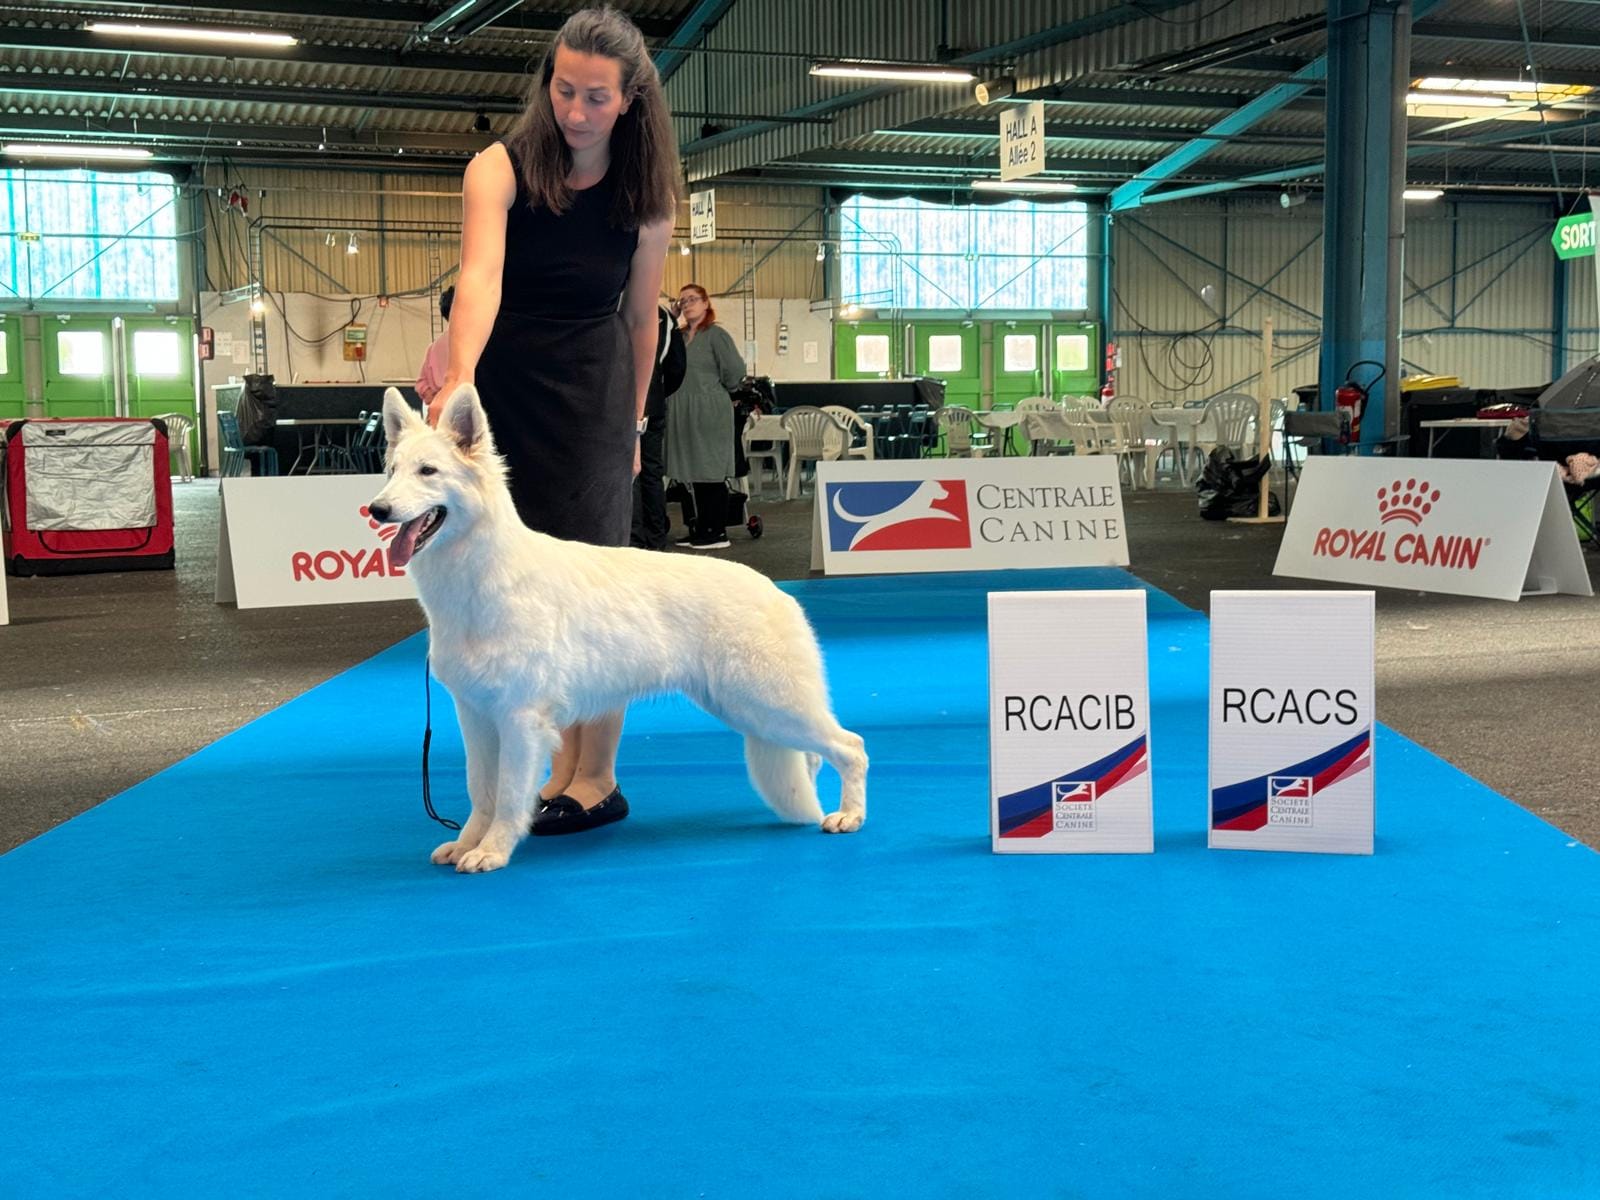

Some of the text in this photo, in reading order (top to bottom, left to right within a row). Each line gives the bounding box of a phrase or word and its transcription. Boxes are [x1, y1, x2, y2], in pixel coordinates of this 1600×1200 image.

[1006, 115, 1037, 143] HALL A
[1008, 140, 1036, 168] Allée 2
[692, 191, 714, 219] HALL A
[709, 220, 714, 239] 1
[1313, 527, 1484, 570] ROYAL CANIN
[292, 548, 406, 581] ROYAL
[1004, 694, 1136, 732] RCACIB
[1223, 687, 1358, 726] RCACS
